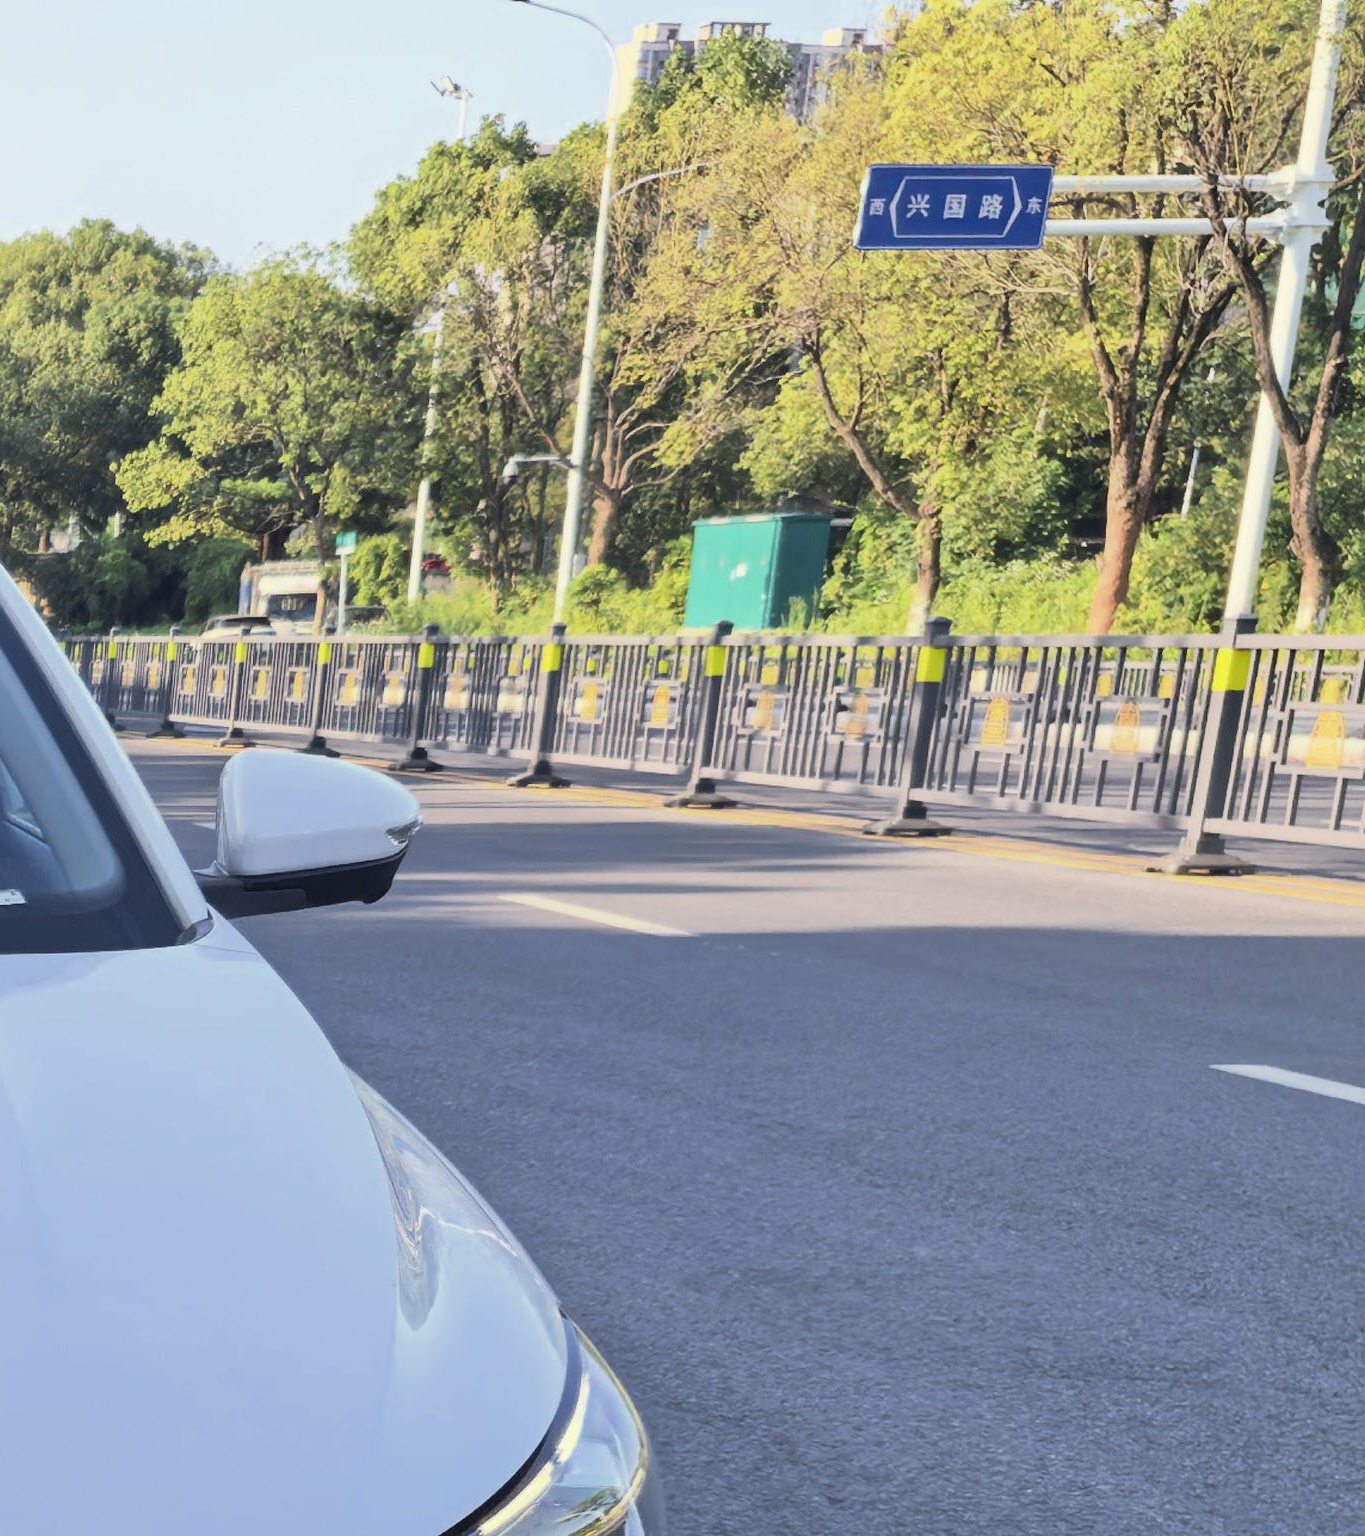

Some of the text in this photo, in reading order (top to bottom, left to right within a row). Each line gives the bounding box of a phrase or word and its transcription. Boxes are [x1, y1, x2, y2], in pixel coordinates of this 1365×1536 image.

[869, 193, 1043, 220] 西 兴国路 东
